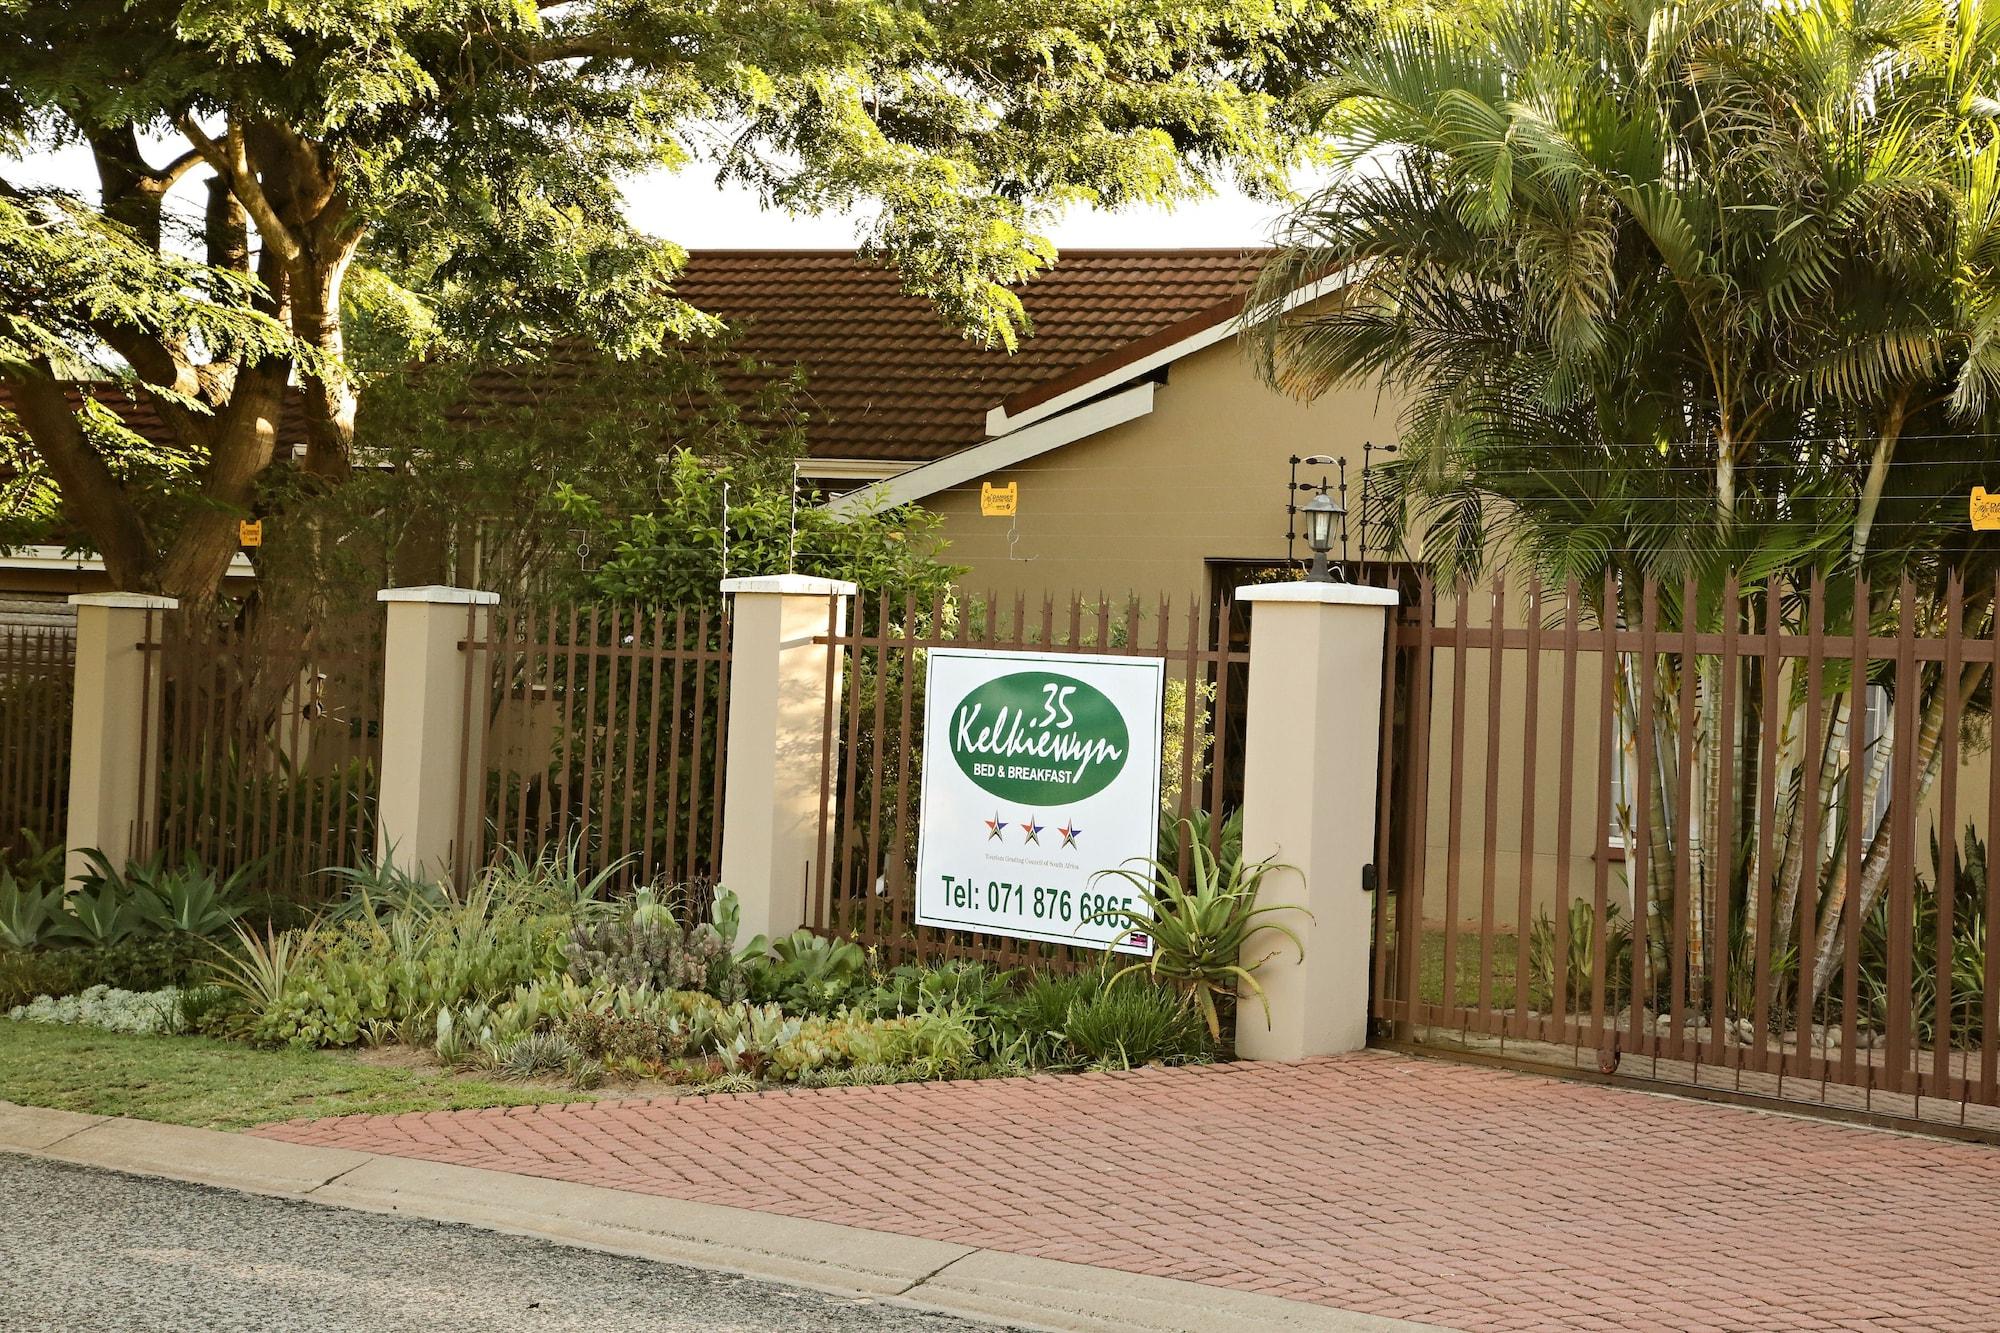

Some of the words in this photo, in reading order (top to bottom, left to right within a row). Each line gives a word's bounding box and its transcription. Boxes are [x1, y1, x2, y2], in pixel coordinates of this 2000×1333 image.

[1038, 683, 1076, 728] 35
[957, 703, 1122, 783] Kelkiewyn
[973, 763, 995, 778] BED
[997, 765, 1006, 778] &
[1007, 765, 1073, 784] BREAKFAST
[941, 875, 979, 910] Tel:
[987, 881, 1024, 916] 071
[1033, 886, 1072, 922] 876
[1080, 892, 1133, 930] 6865
